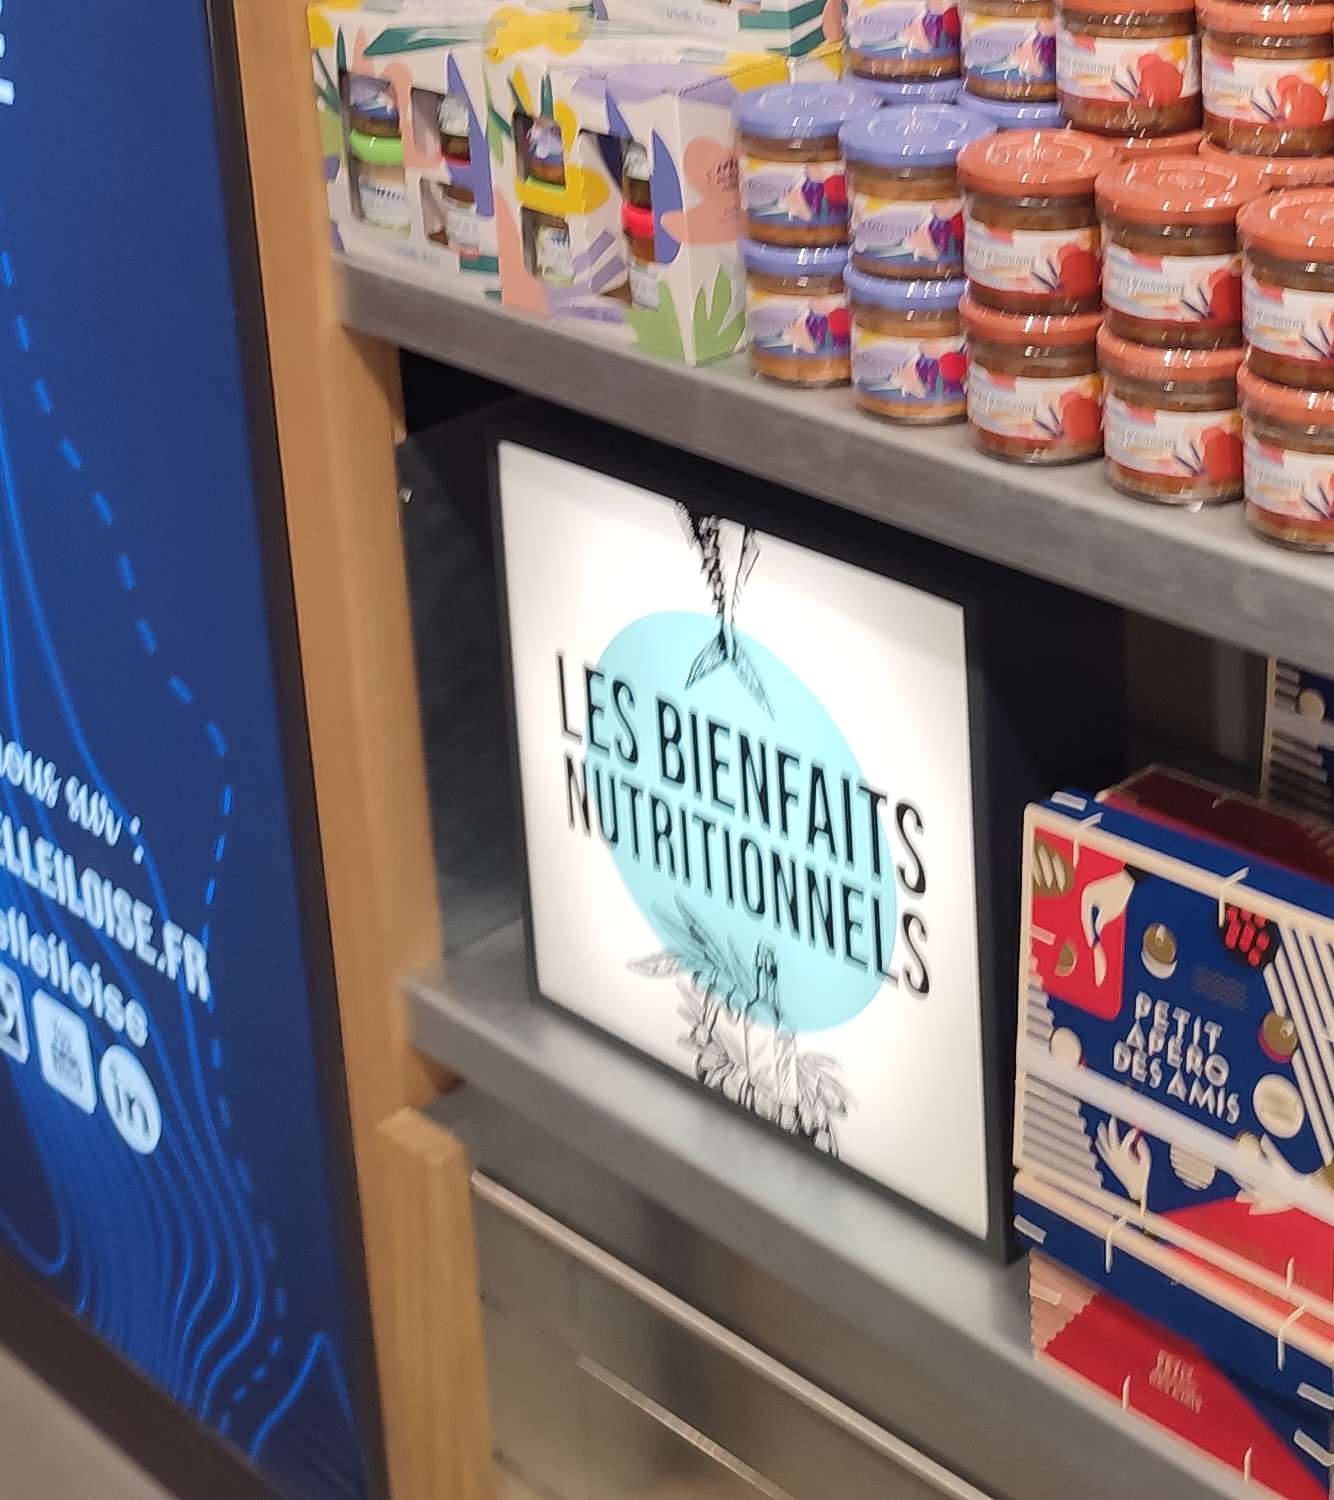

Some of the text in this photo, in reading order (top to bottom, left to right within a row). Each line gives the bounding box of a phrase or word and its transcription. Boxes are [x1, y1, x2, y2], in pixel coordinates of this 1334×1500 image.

[554, 649, 930, 897] LES BIENFAITS
[564, 749, 931, 1000] NUTRITIONNELS
[1113, 1040, 1241, 1125] DES AMIS
[1135, 991, 1223, 1054] PETIT
